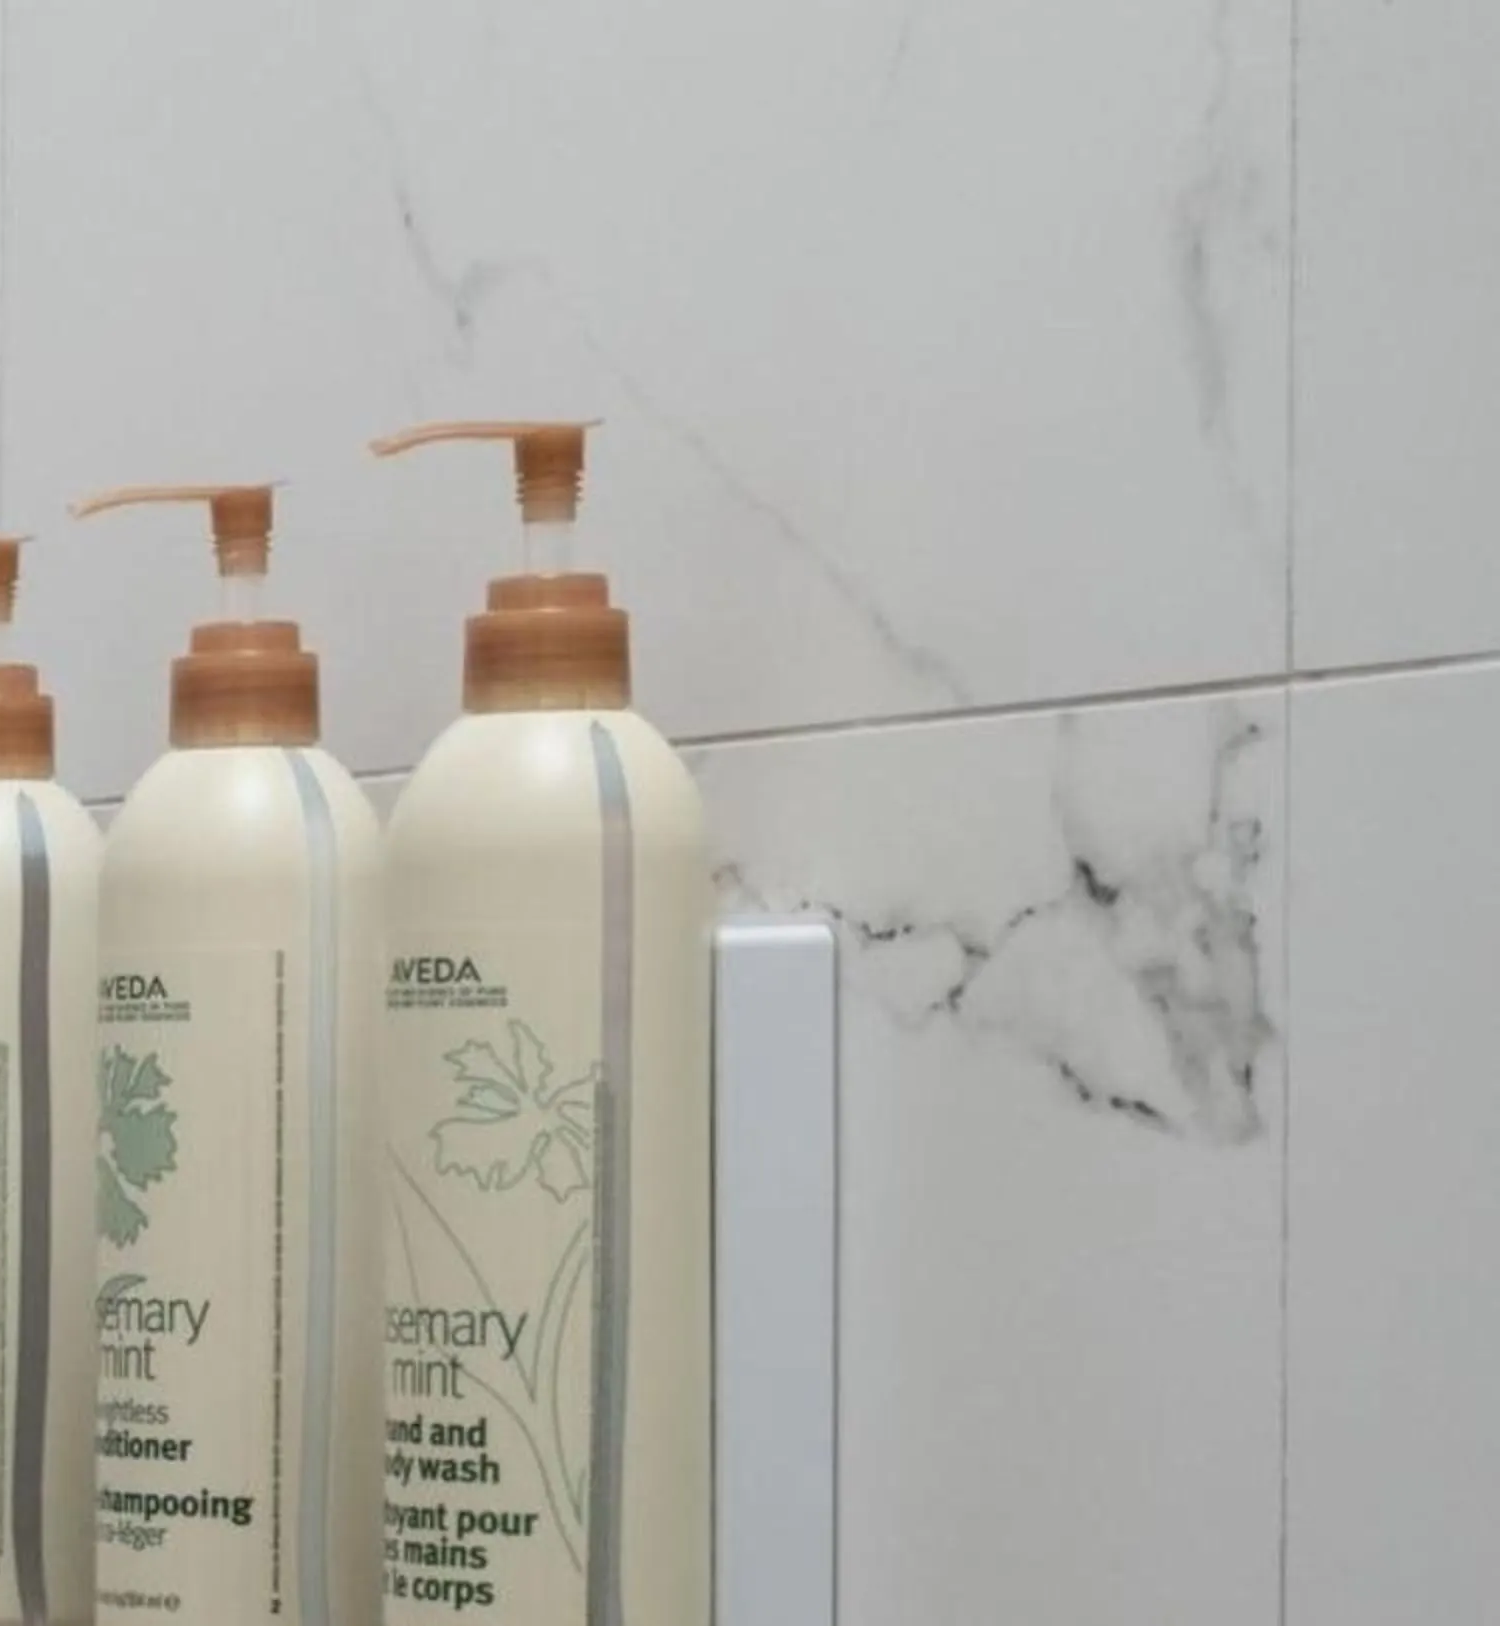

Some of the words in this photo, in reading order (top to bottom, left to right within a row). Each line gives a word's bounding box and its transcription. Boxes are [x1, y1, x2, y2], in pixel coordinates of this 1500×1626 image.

[393, 1347, 465, 1400] mint
[429, 1416, 487, 1448] and
[418, 1452, 501, 1484] wash
[97, 1488, 255, 1527] hampooing
[456, 1509, 539, 1541] pour
[403, 1536, 488, 1570] mains
[411, 1574, 495, 1612] corps
